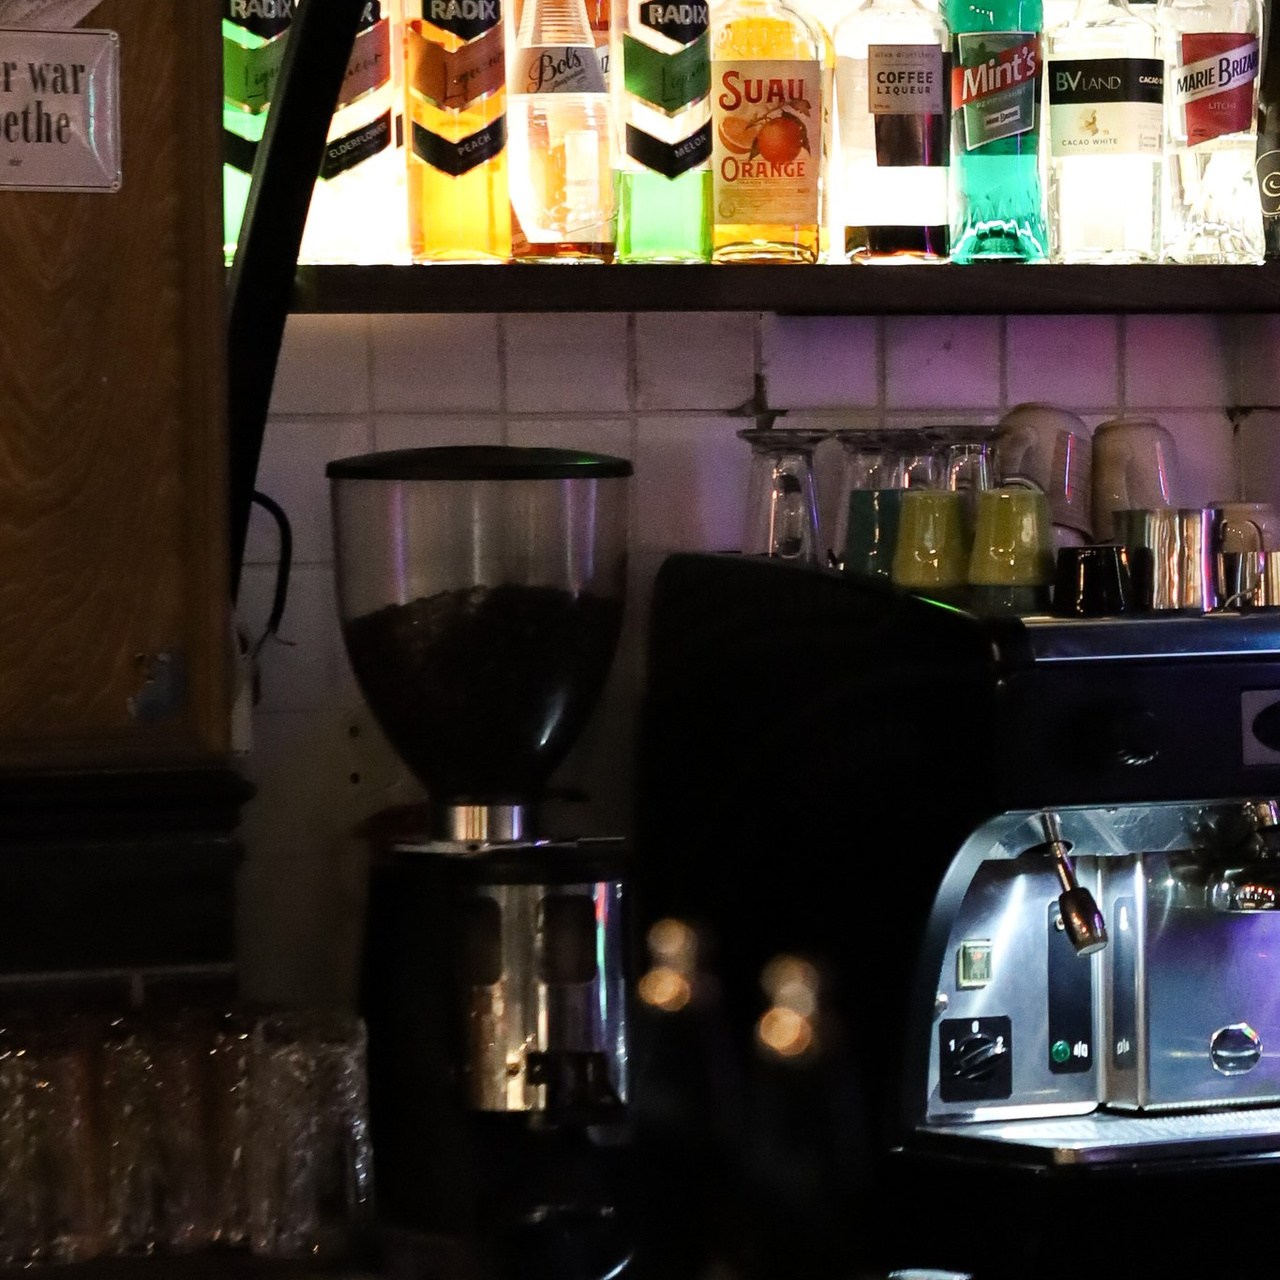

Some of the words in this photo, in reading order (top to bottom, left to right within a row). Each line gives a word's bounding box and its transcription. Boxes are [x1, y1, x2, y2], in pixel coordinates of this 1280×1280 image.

[431, 0, 497, 20] RADIX
[649, 4, 708, 25] RADIX
[28, 62, 86, 95] war
[877, 71, 934, 84] COFFEE
[962, 46, 1036, 101] Mint's
[1176, 66, 1216, 96] MARIE
[877, 86, 931, 96] LIQUEUR
[0, 100, 71, 144] ethe
[458, 133, 491, 156] PEACH
[674, 133, 707, 160] MELON
[1062, 138, 1091, 147] CACAO
[1093, 137, 1119, 146] WHITE
[721, 155, 806, 183] ORANGE
[948, 1038, 956, 1052] 1
[995, 1036, 1005, 1054] 2
